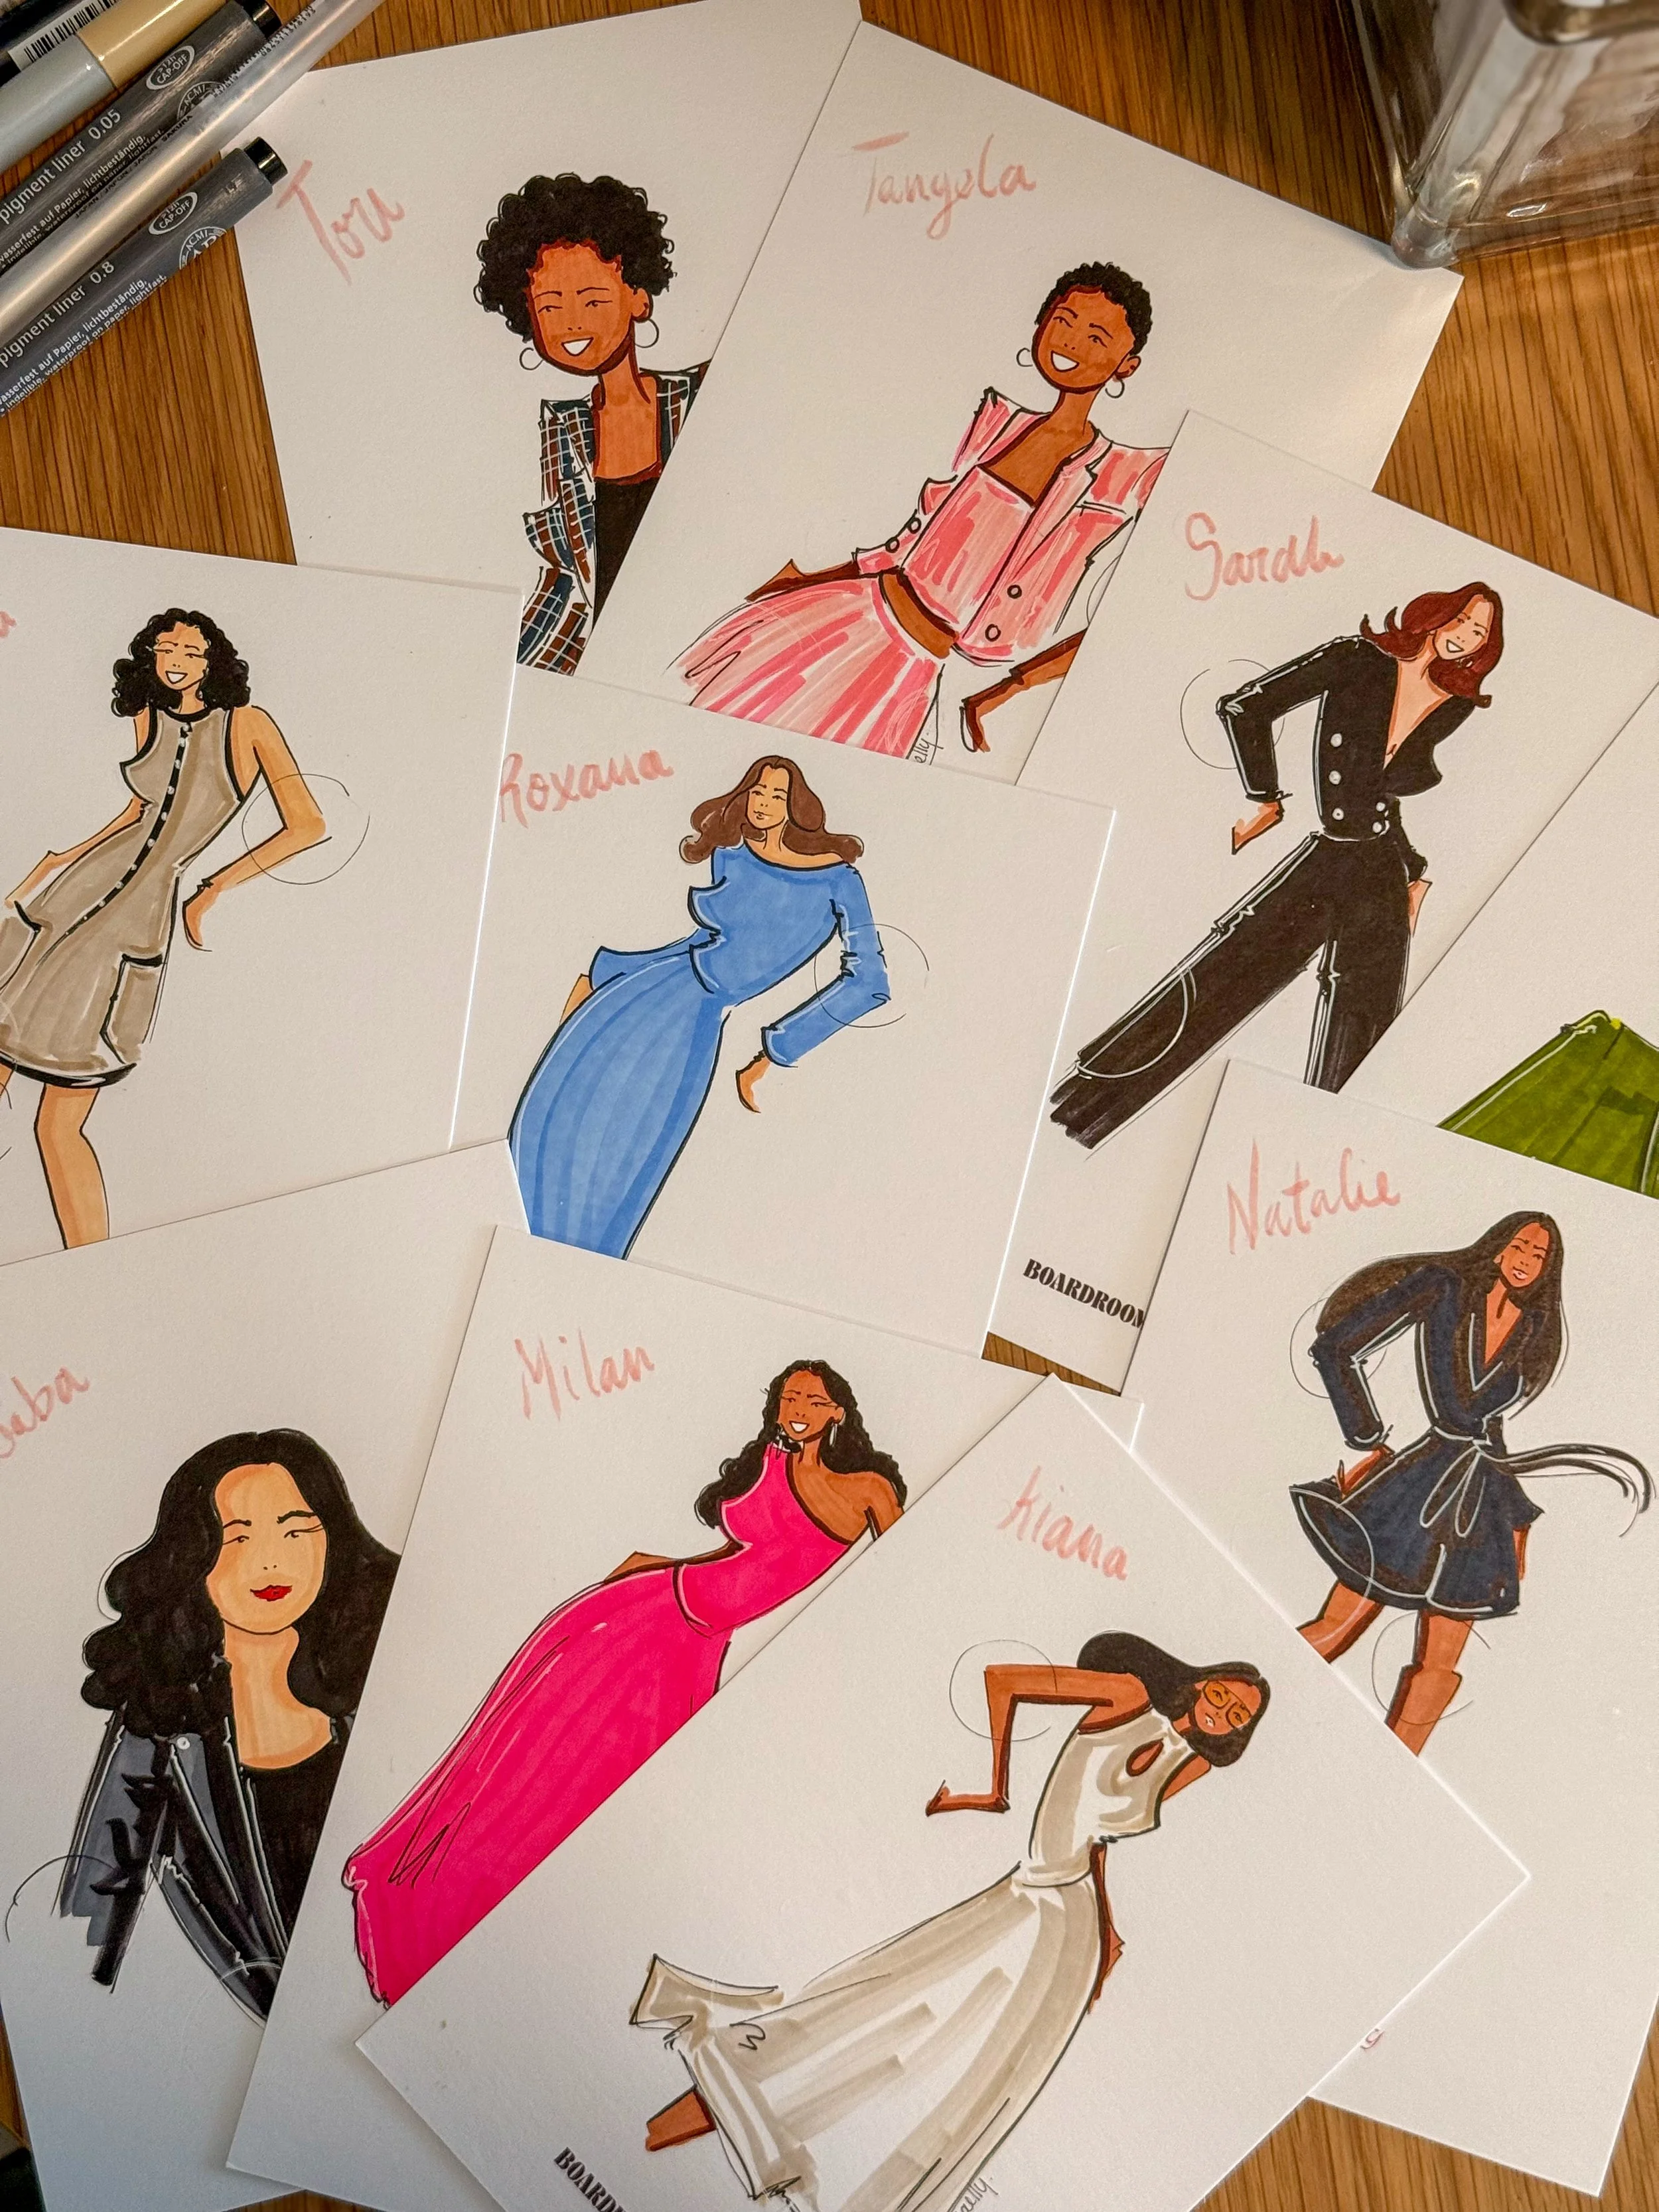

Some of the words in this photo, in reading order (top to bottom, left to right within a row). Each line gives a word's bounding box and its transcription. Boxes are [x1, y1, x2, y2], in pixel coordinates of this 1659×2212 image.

[157, 54, 187, 84] CAP-OFF
[0, 167, 56, 224] pigment
[52, 140, 86, 172] liner
[88, 109, 121, 140] 0.05
[40, 210, 54, 227] auf
[159, 200, 190, 228] CAP-OFF
[186, 230, 208, 252] ACMI
[0, 312, 56, 368] pigment
[52, 285, 86, 315] liner
[90, 261, 115, 284] 0.8
[0, 368, 39, 405] asserfest
[38, 352, 54, 371] auf
[53, 332, 84, 357] Papier,
[44, 334, 90, 376] waterproof
[1185, 512, 1345, 601] Sarah
[498, 749, 675, 829] Roxana
[1226, 1137, 1401, 1256] Natalie
[514, 1327, 655, 1422] Milan
[553, 2146, 626, 2212] BOARD
